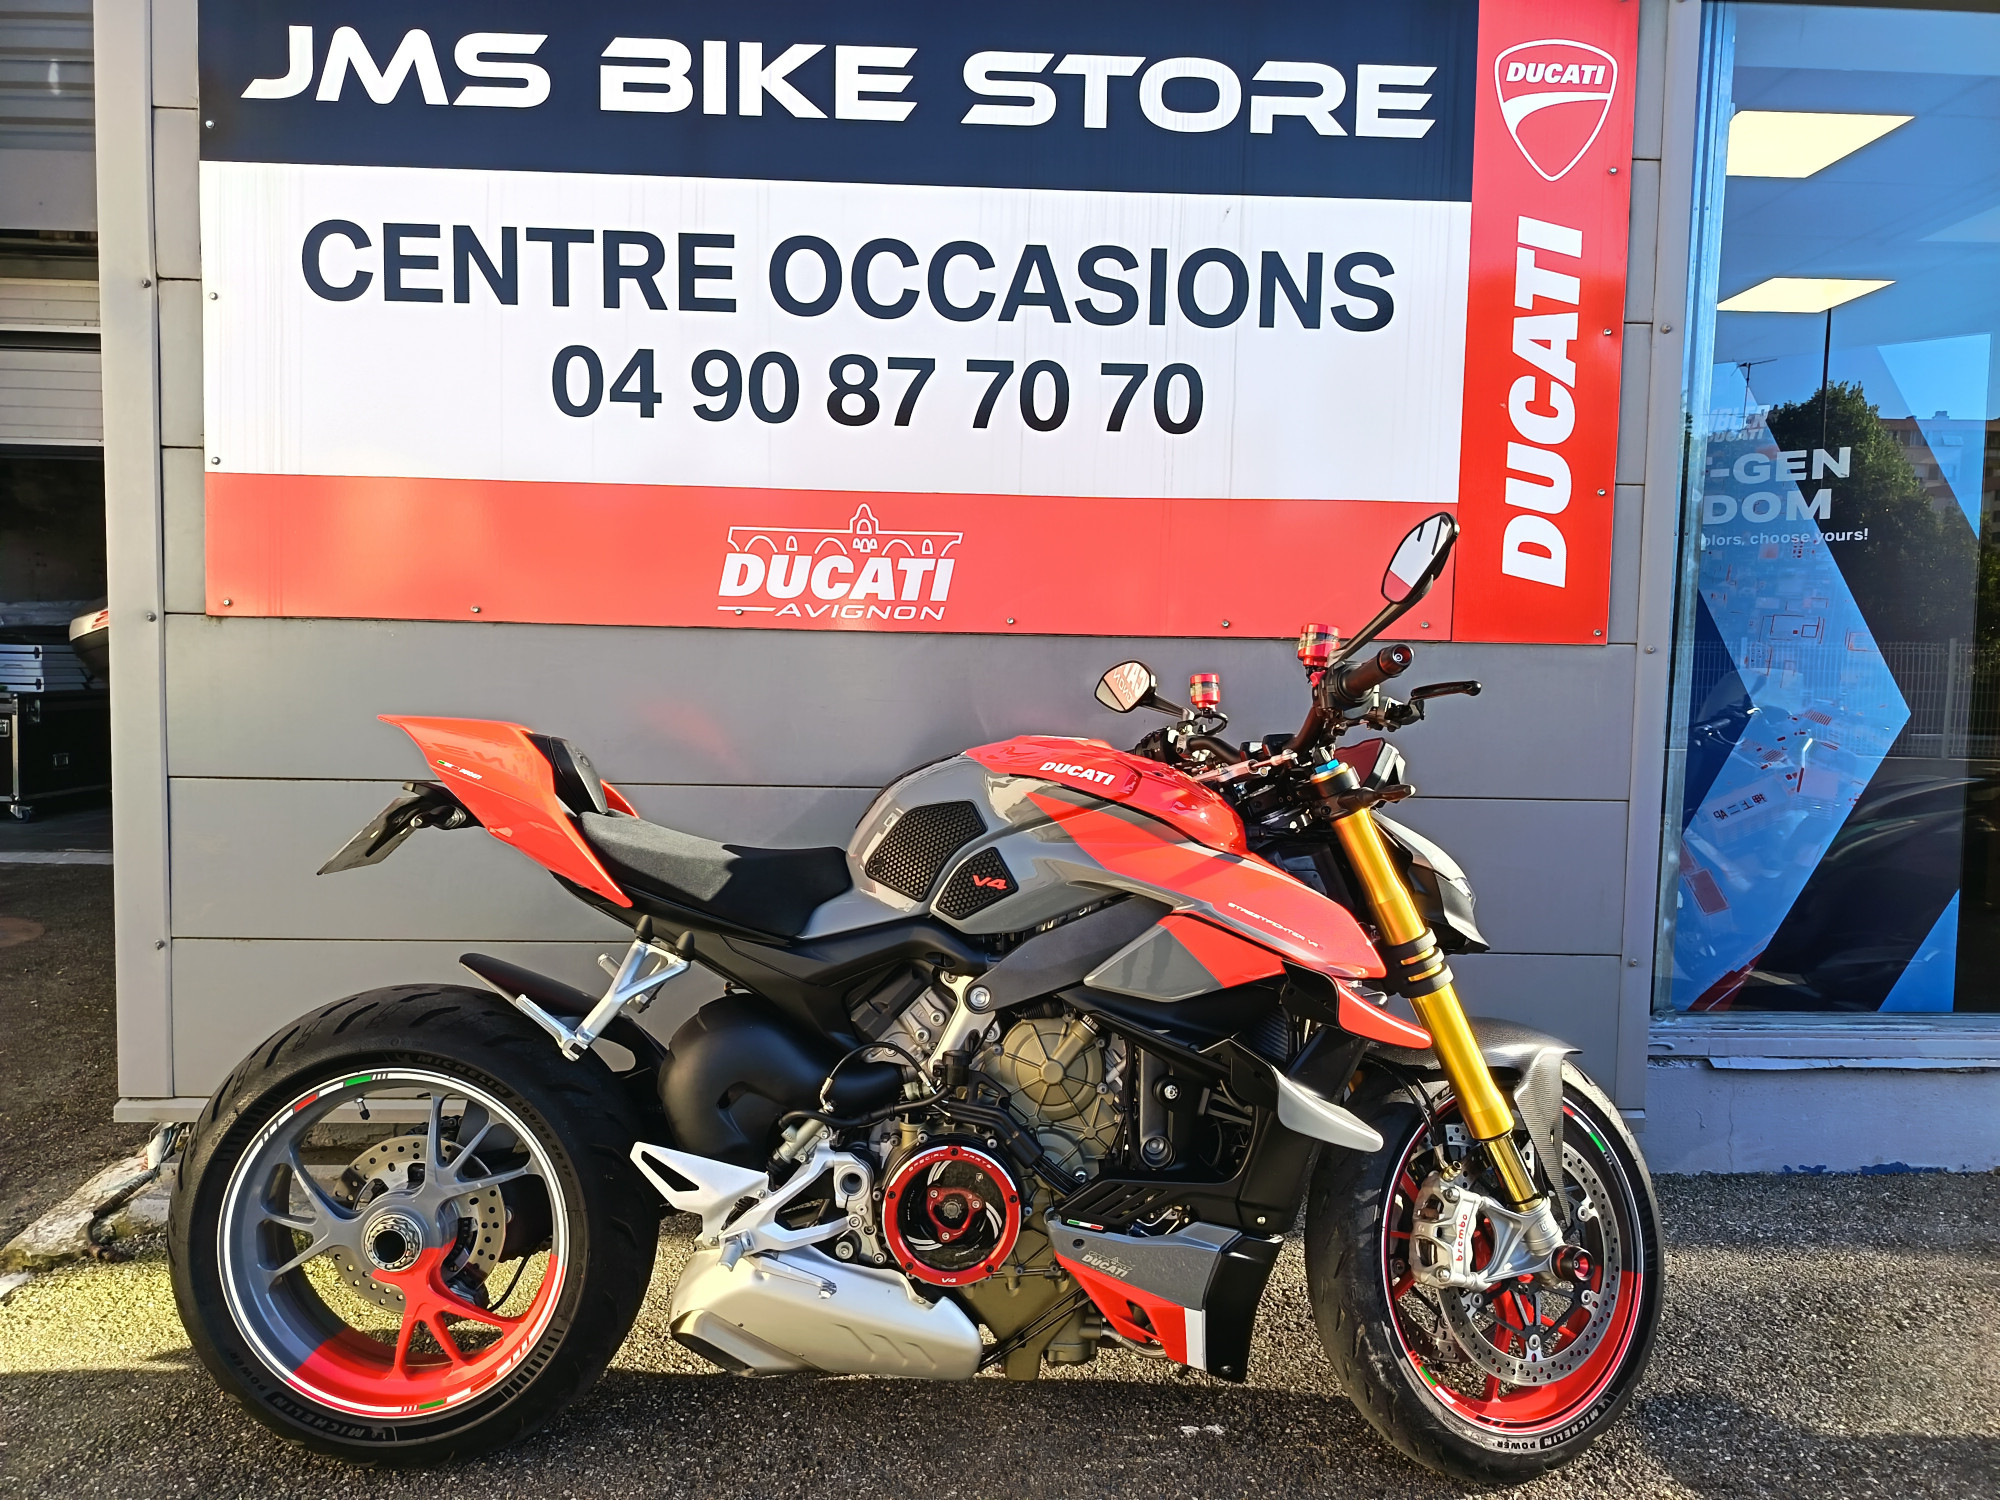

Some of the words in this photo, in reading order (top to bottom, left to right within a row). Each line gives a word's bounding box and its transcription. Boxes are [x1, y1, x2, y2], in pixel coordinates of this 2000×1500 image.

[240, 25, 551, 108] JMS
[600, 37, 918, 121] BIKE
[961, 50, 1438, 138] STORE
[1505, 62, 1606, 85] DUCATI
[302, 219, 737, 313] CENTRE
[768, 235, 1395, 333] OCCASIONS
[552, 345, 662, 419] 04
[691, 349, 800, 424] 90
[827, 354, 936, 427] 87
[966, 359, 1070, 432] 70
[1101, 363, 1204, 434] 70
[1502, 215, 1583, 588] DUCATI
[1750, 531, 1810, 546] choose
[1815, 528, 1868, 548] yours!
[718, 553, 955, 602] DUCATI
[775, 603, 945, 621] AVIGNON
[1039, 762, 1115, 785] DUCATI
[972, 875, 1008, 890] V4
[416, 1055, 510, 1097] MICHELIN
[1456, 1214, 1468, 1262] brembo
[1082, 1254, 1129, 1278] DUCATI
[273, 1396, 366, 1439] MICHELIN
[1544, 1409, 1599, 1446] MICHELIN
